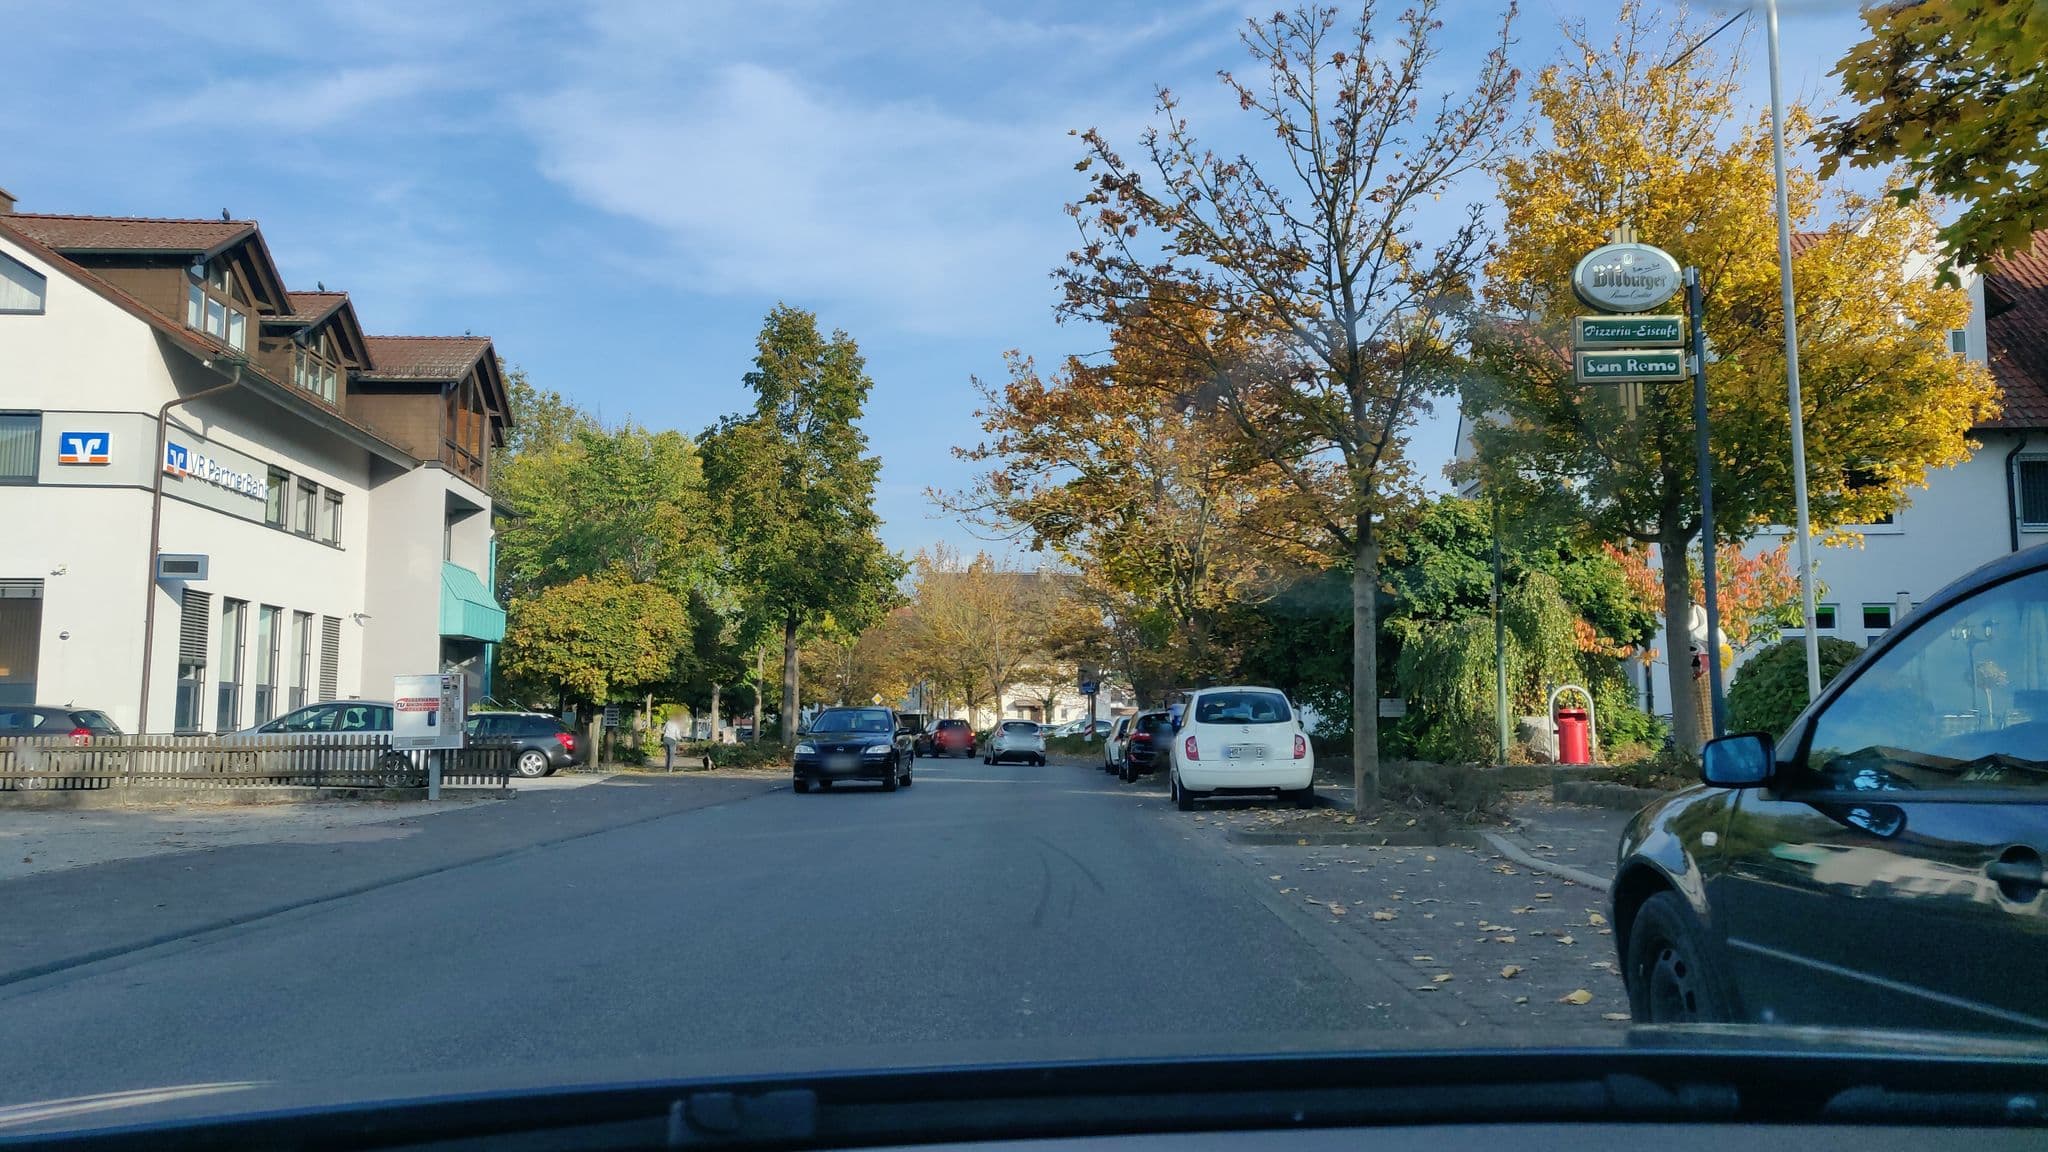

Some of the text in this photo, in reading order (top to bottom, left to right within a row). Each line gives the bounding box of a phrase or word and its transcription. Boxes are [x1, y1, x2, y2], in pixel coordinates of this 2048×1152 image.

[1587, 359, 1676, 373] San Remo
[190, 451, 206, 479] VR
